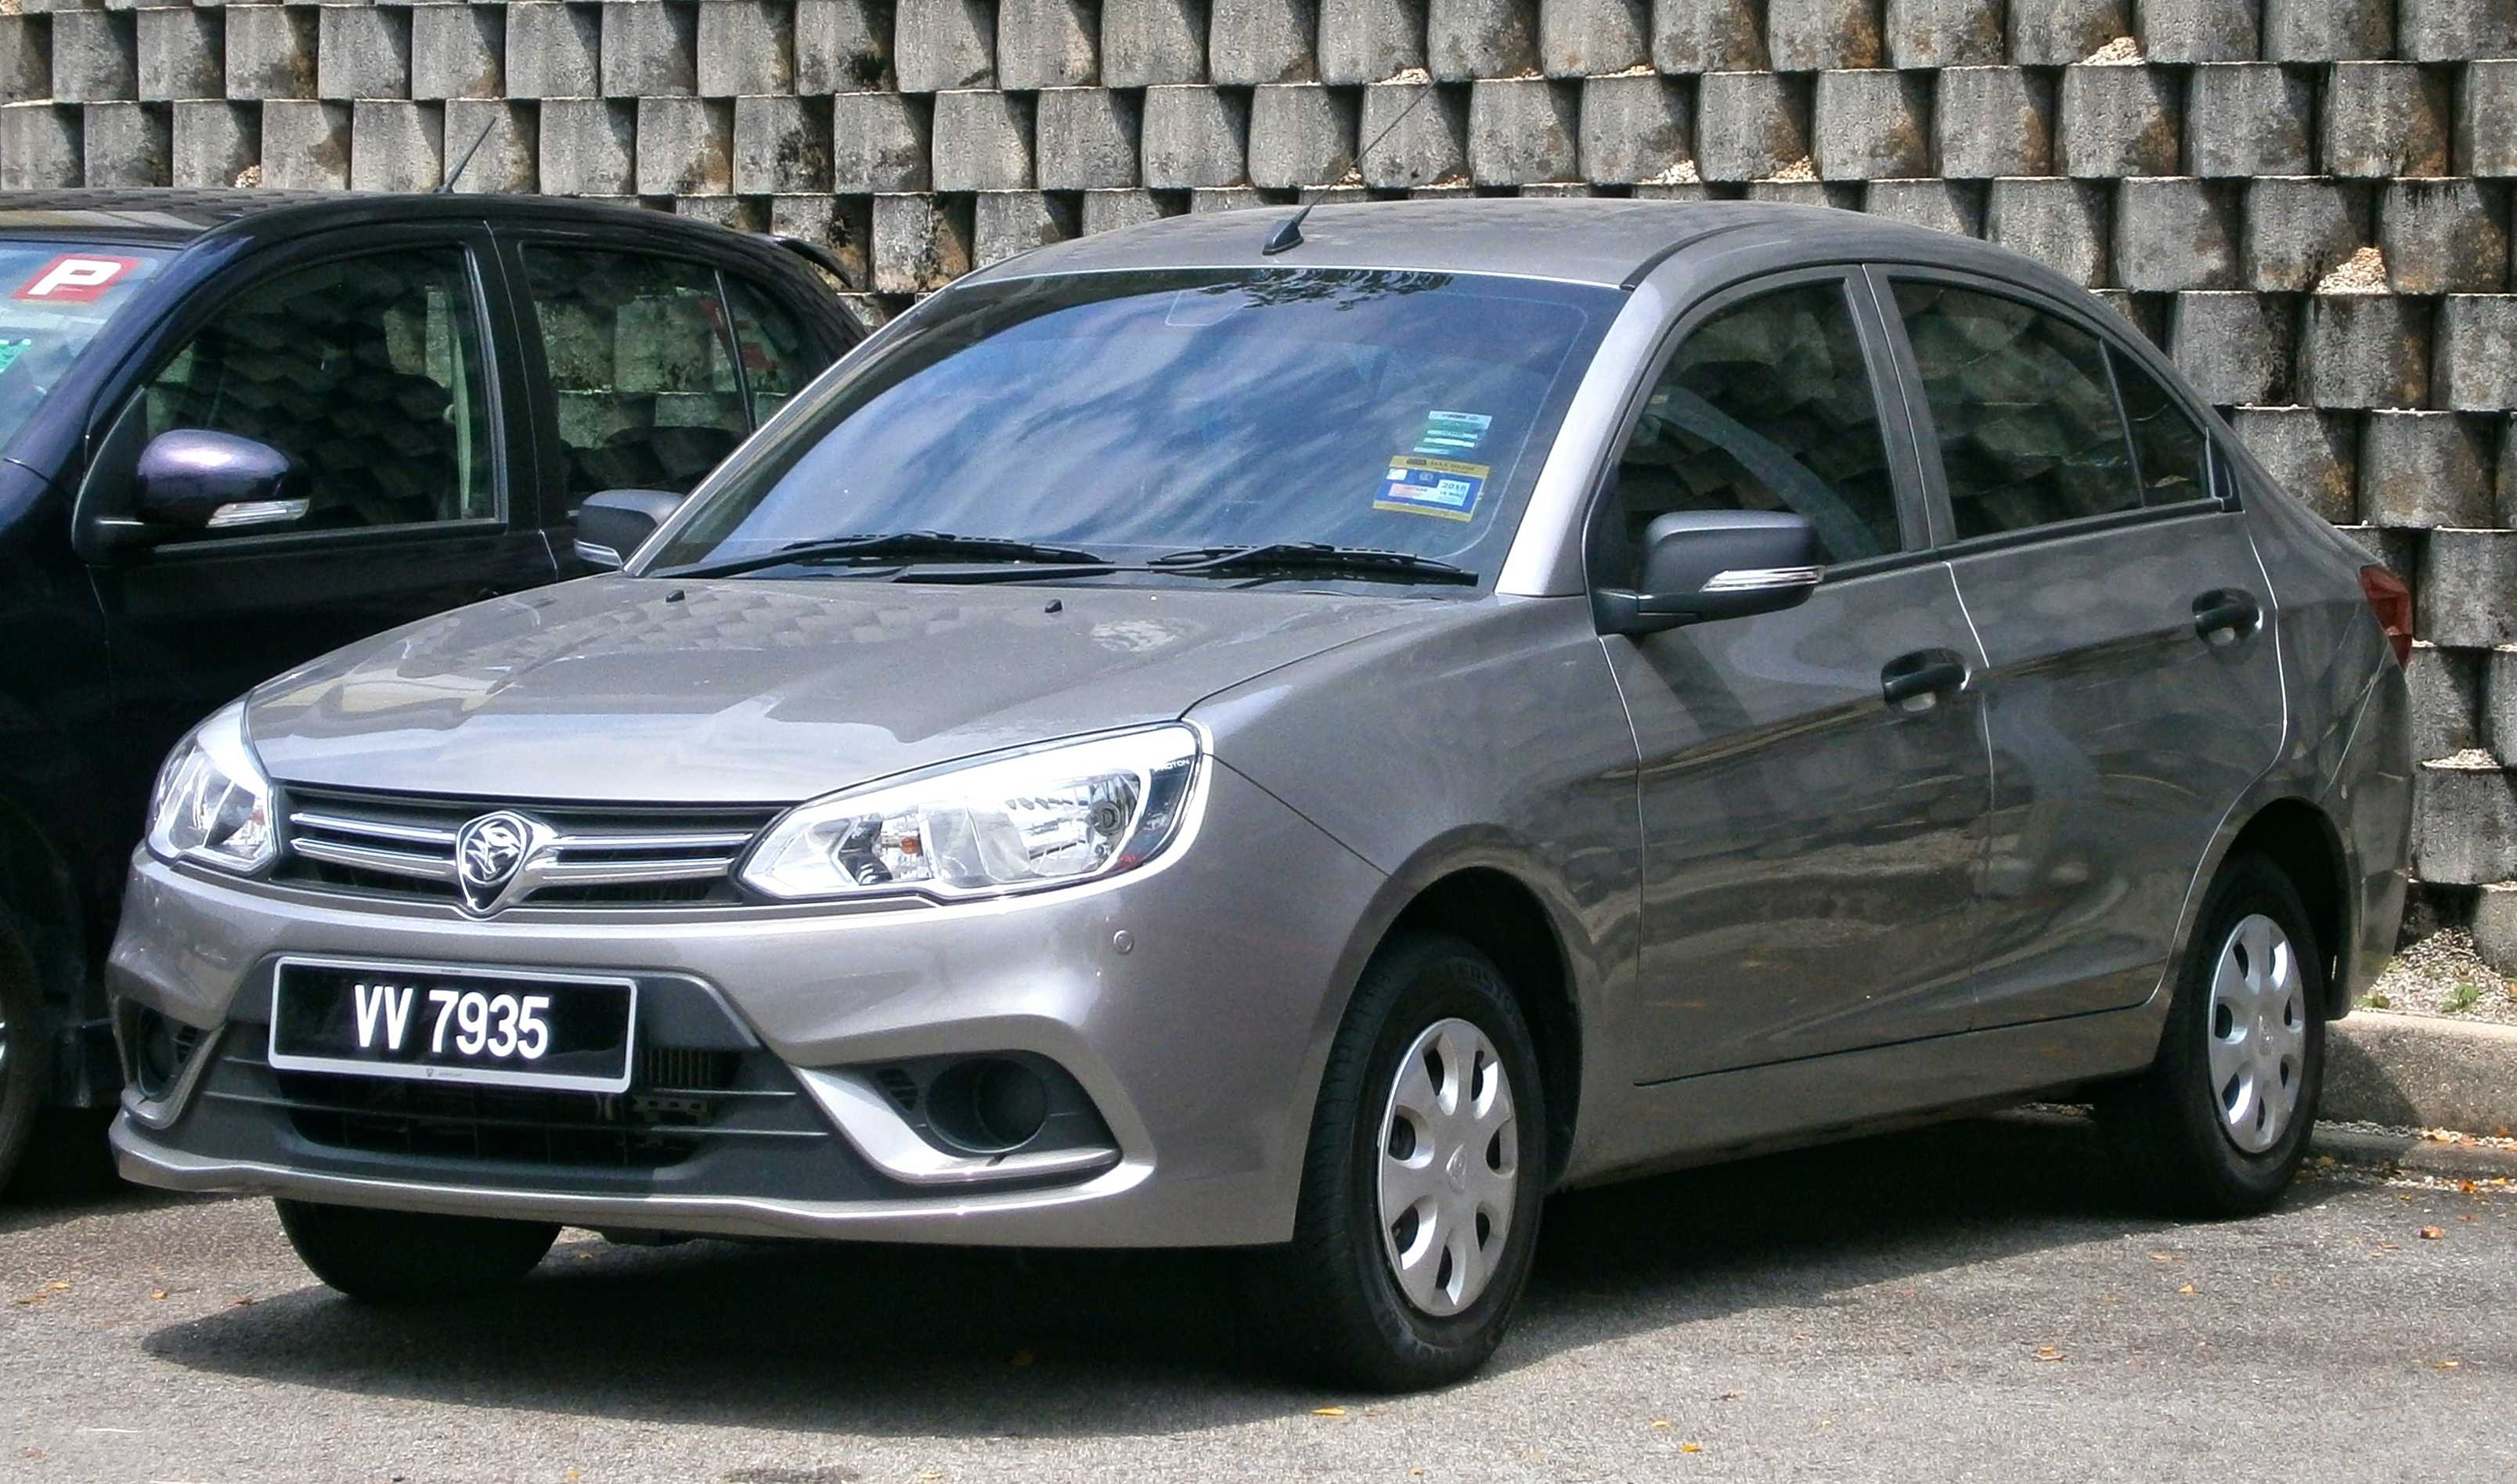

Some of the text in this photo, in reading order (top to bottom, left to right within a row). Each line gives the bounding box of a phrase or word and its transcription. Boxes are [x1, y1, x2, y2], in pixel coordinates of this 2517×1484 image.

[27, 259, 121, 295] P
[1153, 758, 1190, 773] OTON
[354, 984, 550, 1059] VV 7935
